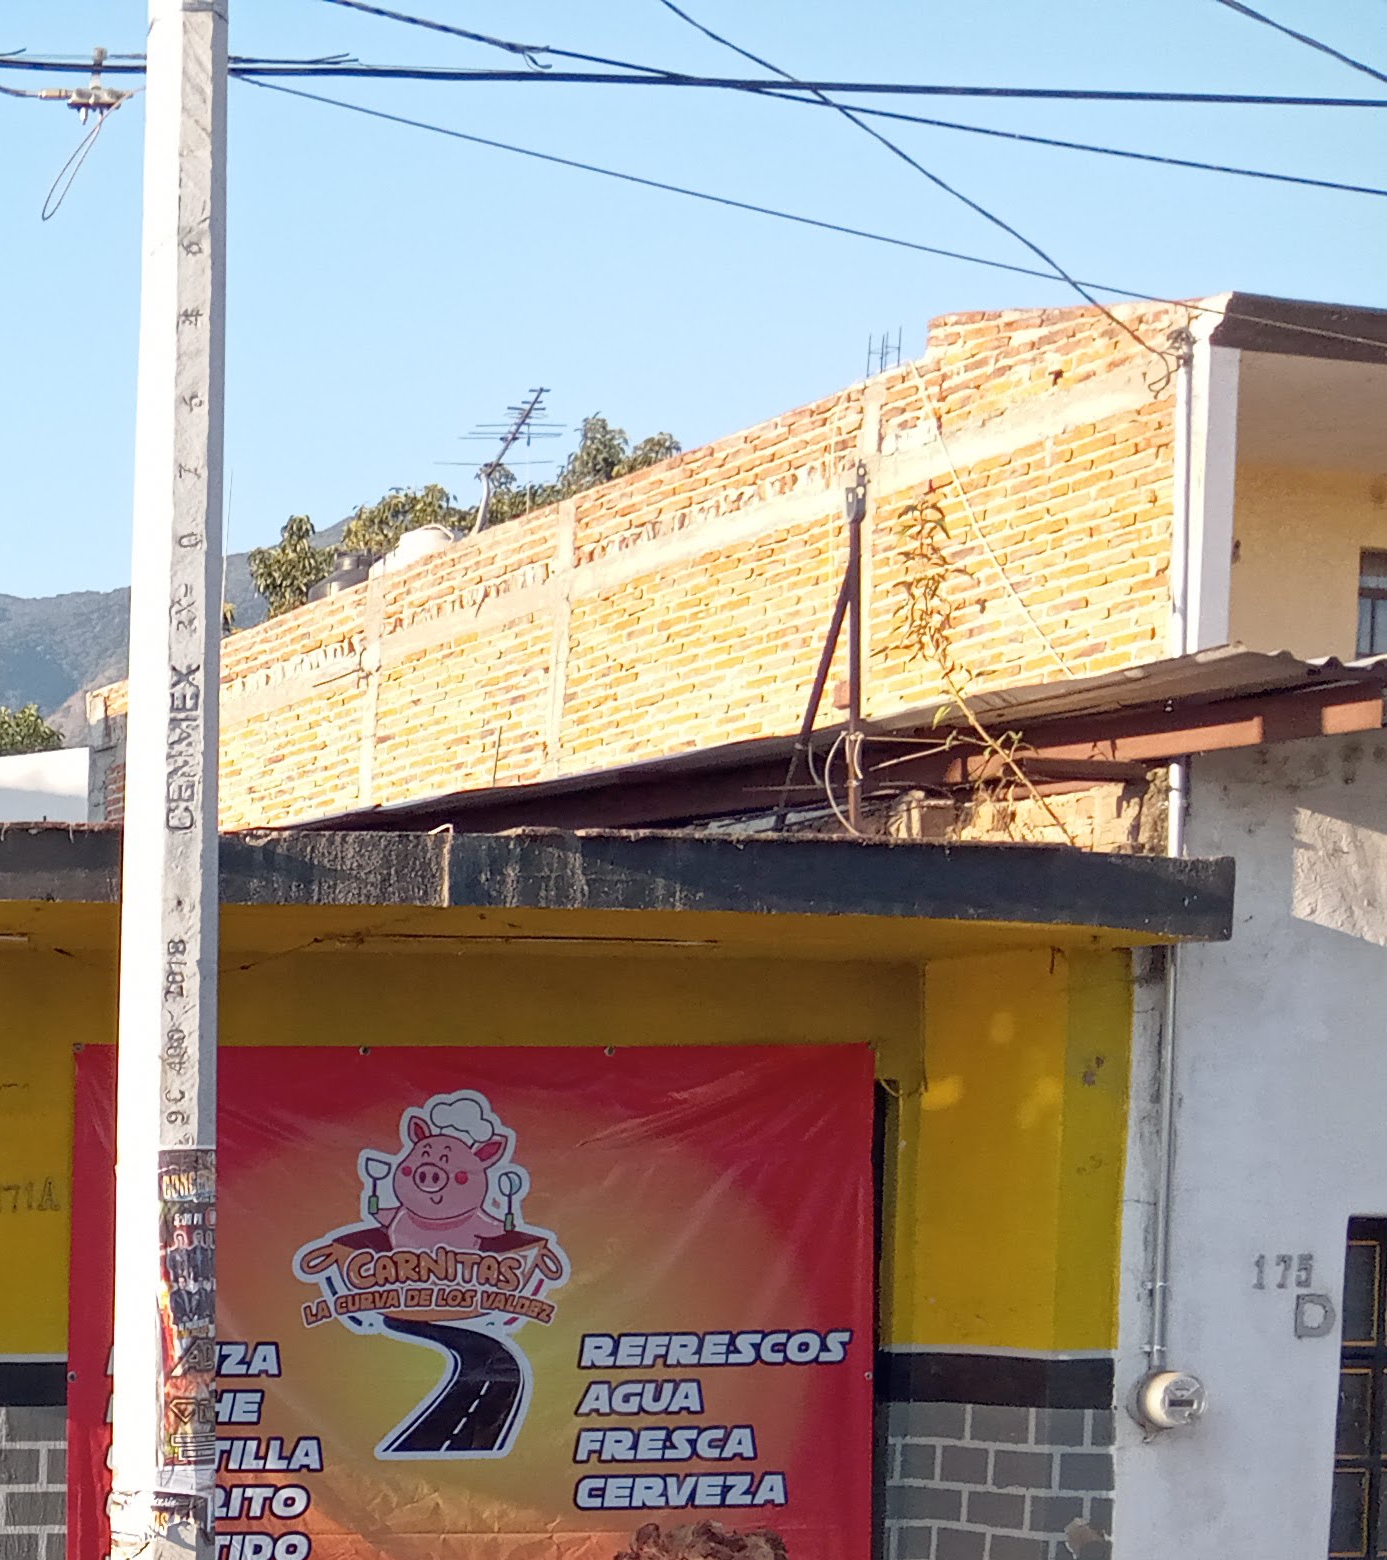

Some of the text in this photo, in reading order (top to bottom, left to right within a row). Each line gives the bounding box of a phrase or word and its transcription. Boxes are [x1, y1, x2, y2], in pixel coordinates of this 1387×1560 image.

[347, 1246, 522, 1291] CARNITAS
[1251, 1252, 1315, 1291] 175
[304, 1288, 556, 1325] LA CURVA DE LOS VALDEZ
[1293, 1293, 1337, 1340] D
[579, 1329, 852, 1368] REFRESCOS
[575, 1379, 704, 1416] AGUA
[574, 1424, 757, 1463] FRESCA
[574, 1471, 788, 1510] CERVEZA
